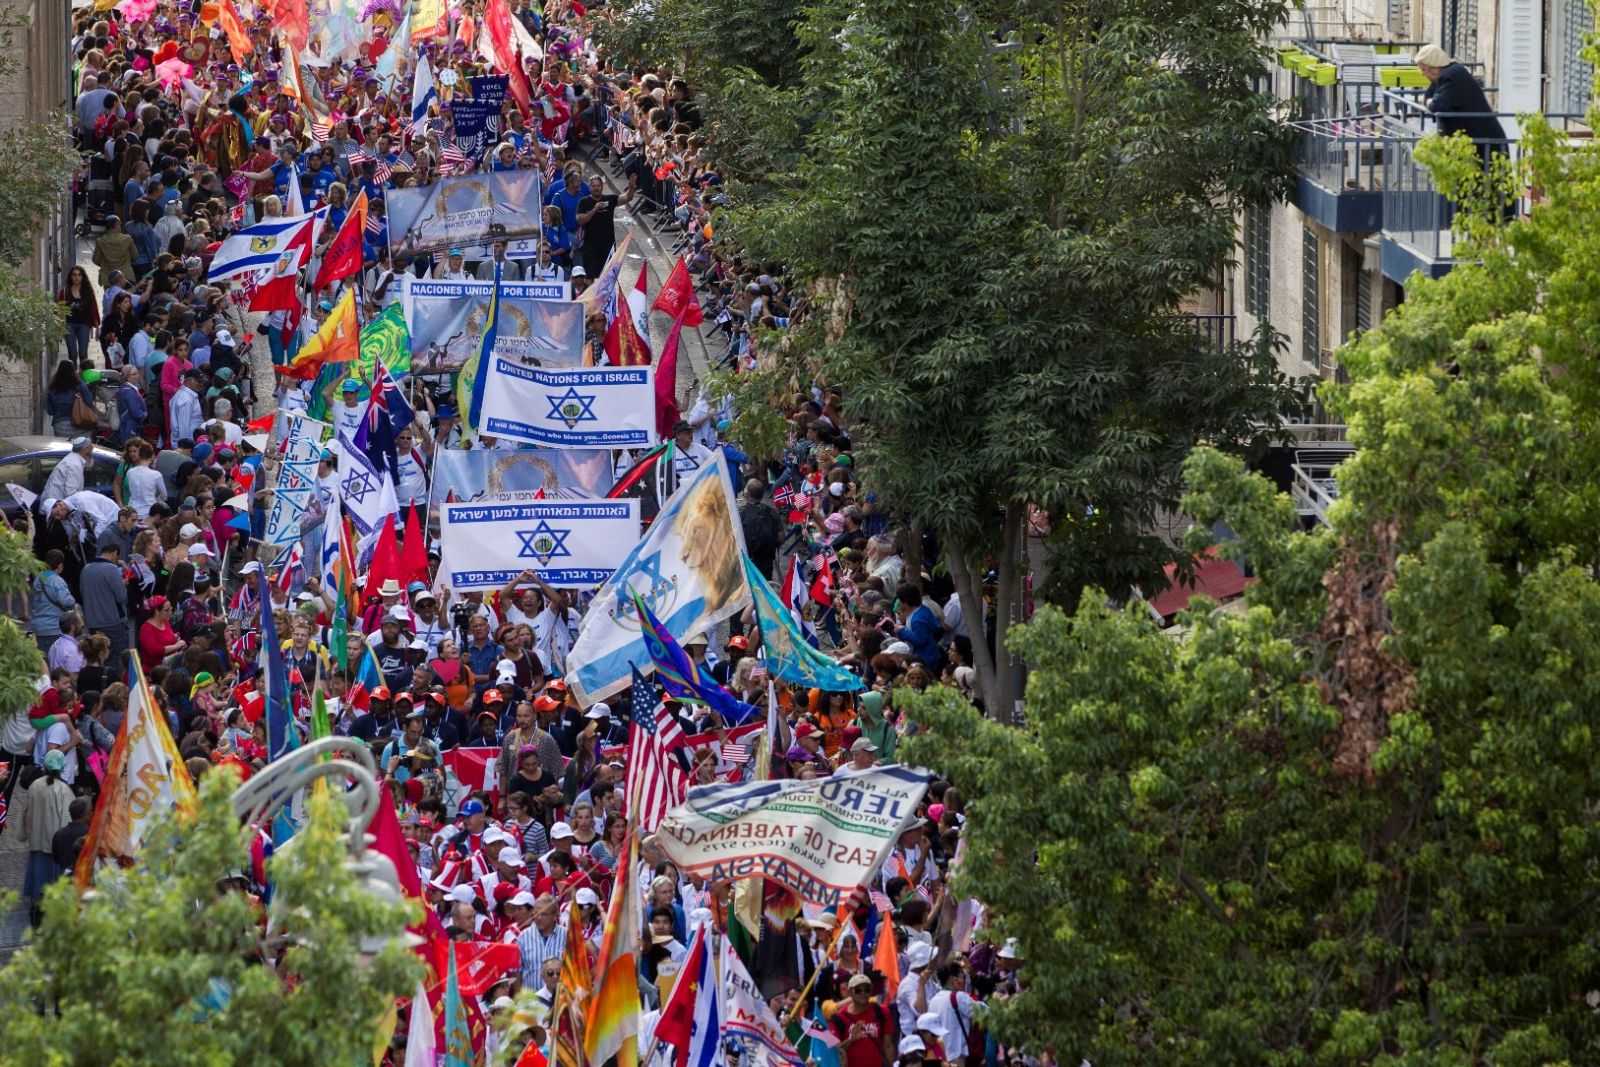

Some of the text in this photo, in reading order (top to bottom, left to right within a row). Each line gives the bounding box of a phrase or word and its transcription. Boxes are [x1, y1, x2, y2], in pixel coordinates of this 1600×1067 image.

[412, 284, 561, 298] NACIONES UNIDA POR ISRAEL
[500, 362, 643, 384] UNITED NATIONS FOR ISRAEL
[494, 421, 507, 429] will
[509, 423, 527, 433] bless
[528, 427, 546, 437] those
[547, 431, 562, 440] who
[451, 506, 627, 521] האומות המאוחדות למען ישראל
[456, 574, 463, 583] 3
